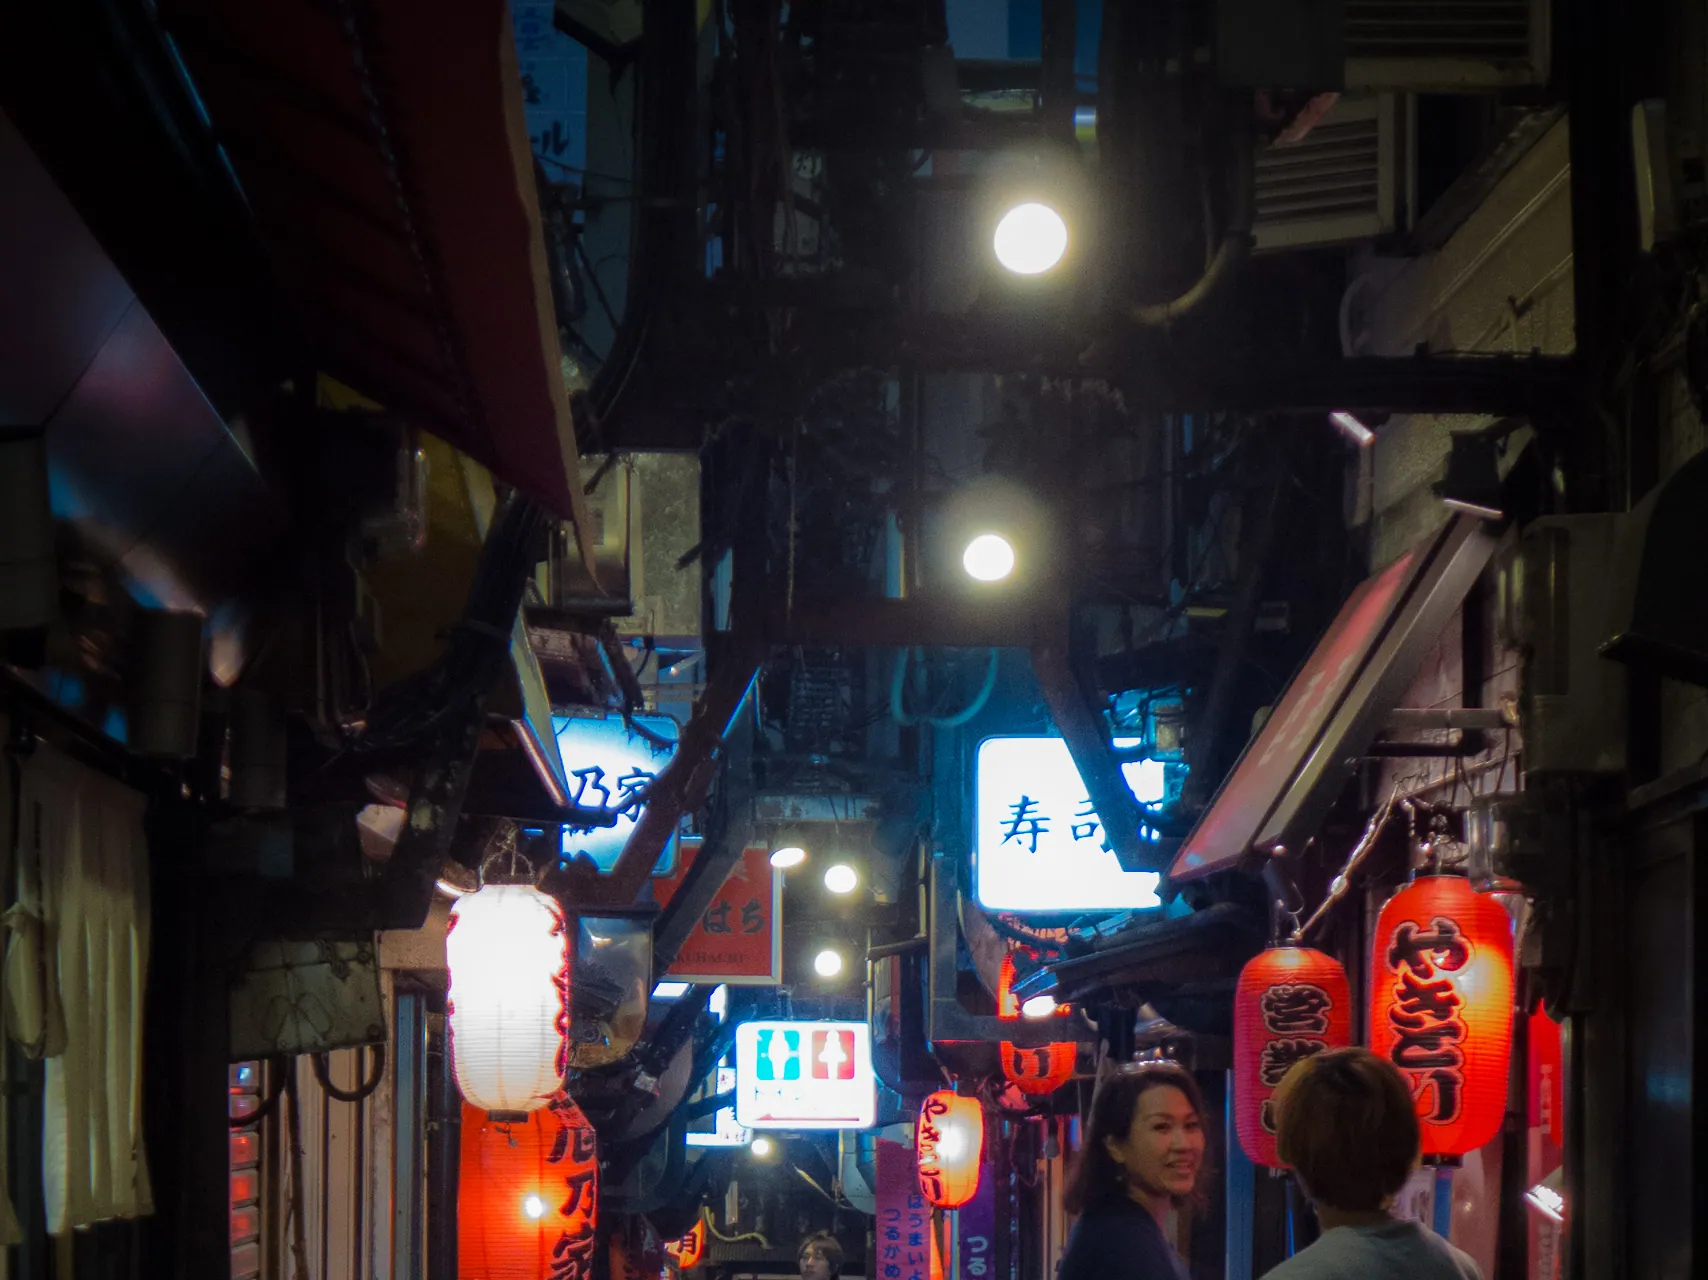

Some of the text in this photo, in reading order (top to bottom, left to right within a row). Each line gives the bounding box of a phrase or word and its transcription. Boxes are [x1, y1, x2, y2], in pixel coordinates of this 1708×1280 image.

[1260, 984, 1332, 1135] 営業
[1387, 917, 1474, 1125] やきとり
